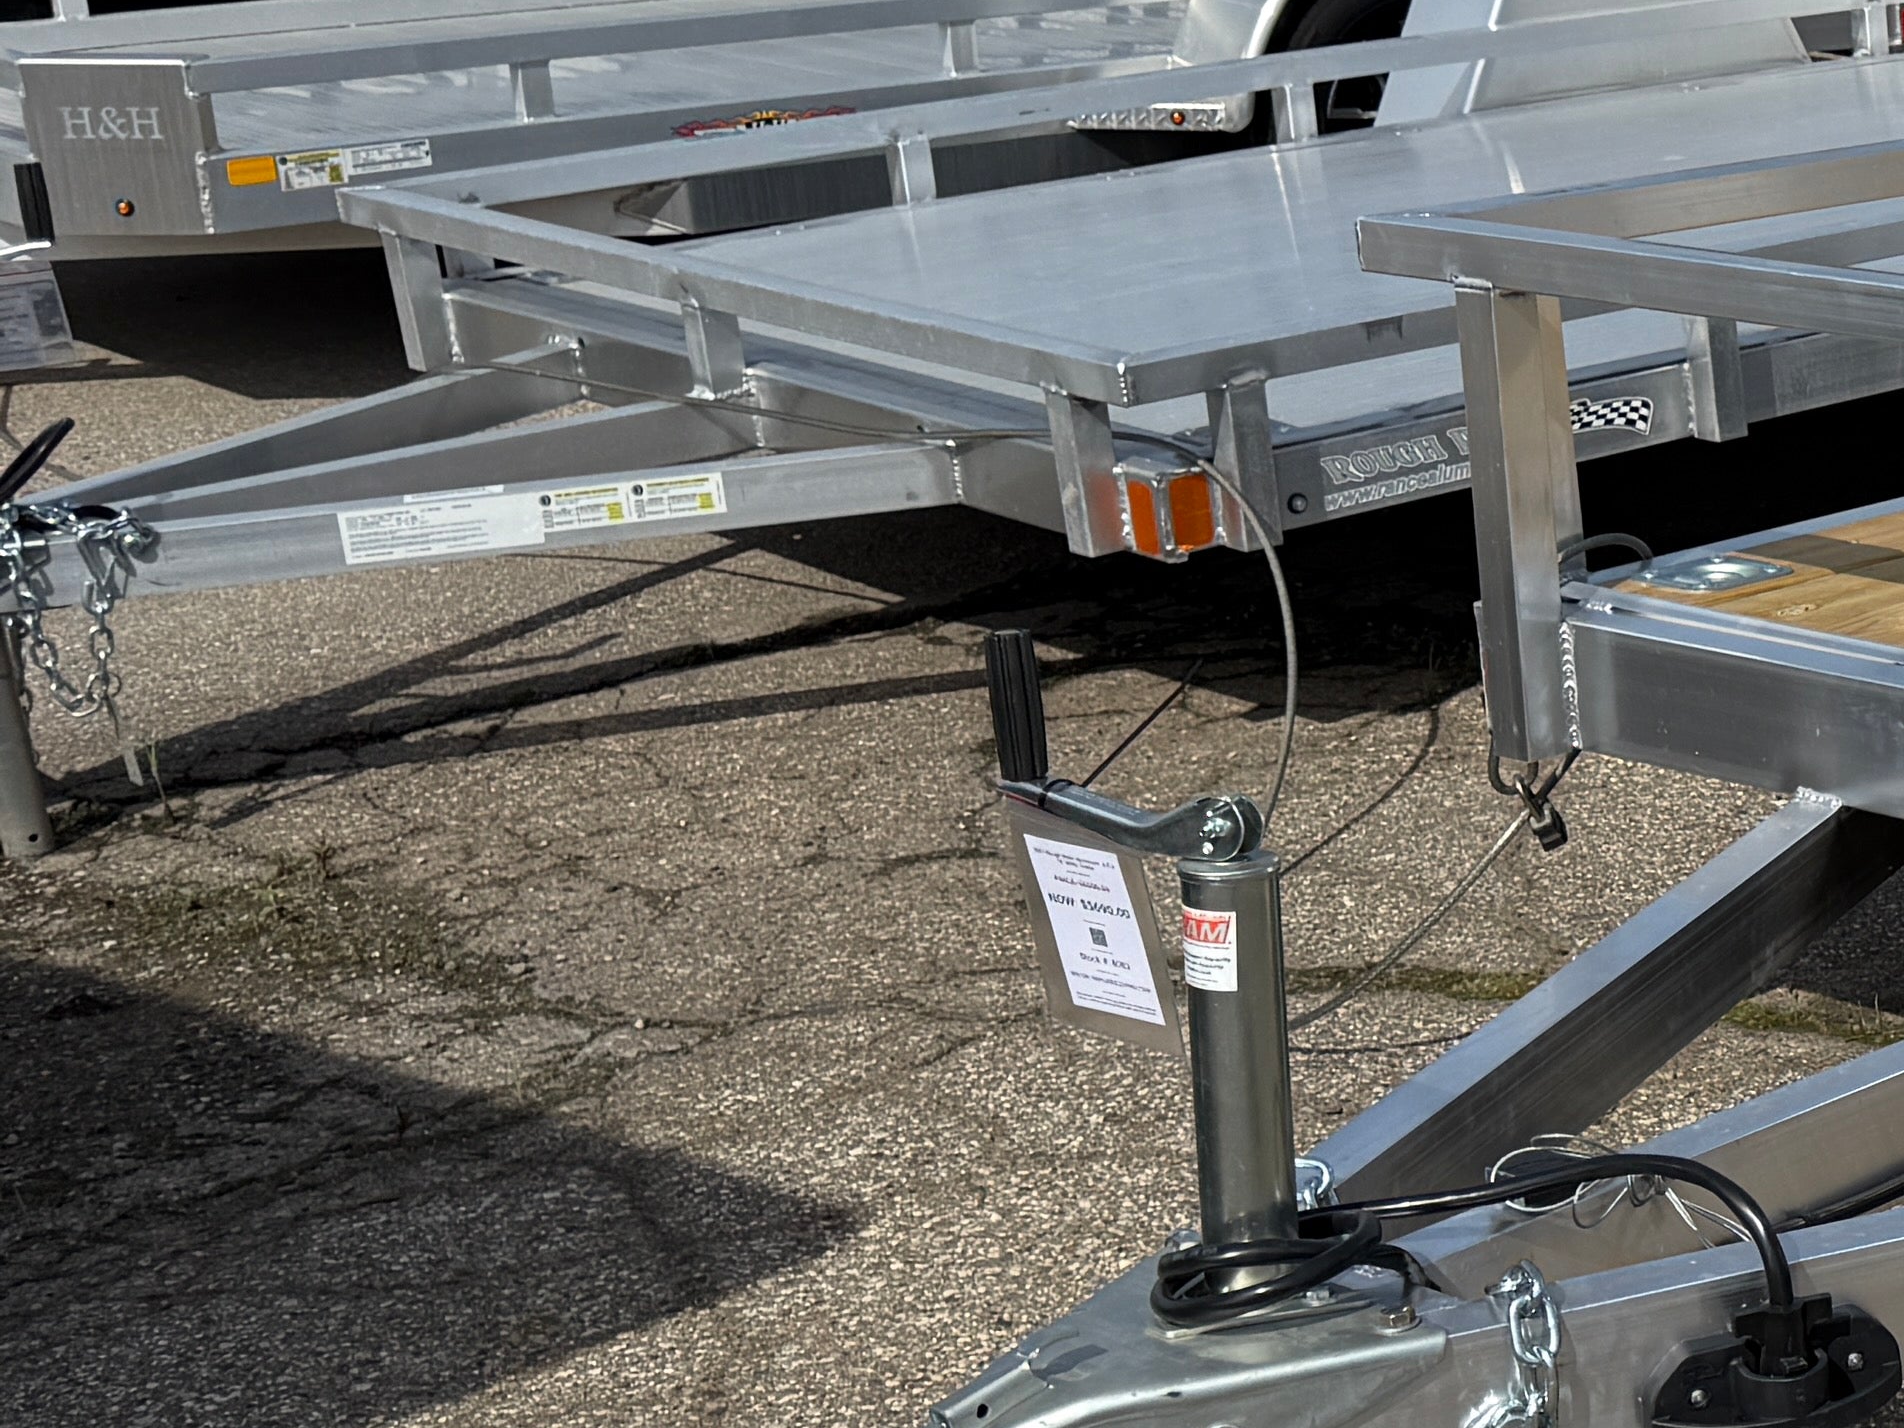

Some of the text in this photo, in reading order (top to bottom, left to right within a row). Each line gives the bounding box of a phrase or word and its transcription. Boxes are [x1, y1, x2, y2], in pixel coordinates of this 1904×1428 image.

[57, 106, 164, 140] H&H
[1320, 435, 1448, 485] ROUGH
[1324, 462, 1472, 512] www.rancealum
[1185, 918, 1228, 943] AM
